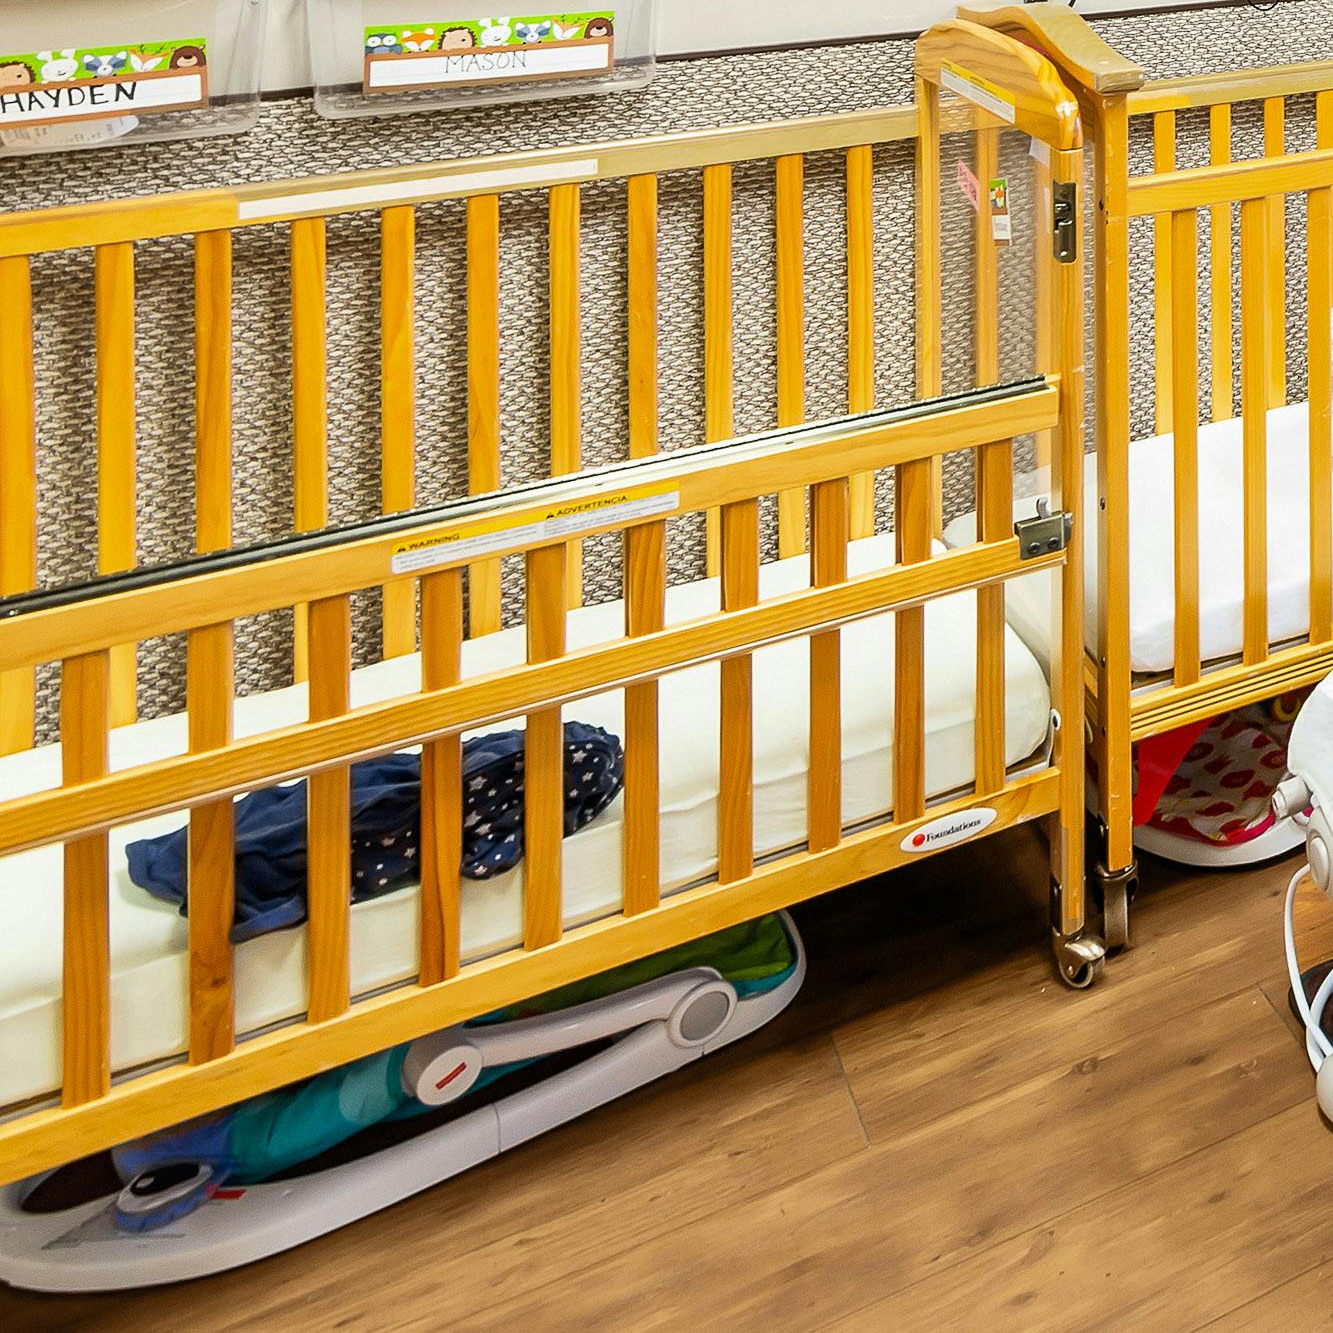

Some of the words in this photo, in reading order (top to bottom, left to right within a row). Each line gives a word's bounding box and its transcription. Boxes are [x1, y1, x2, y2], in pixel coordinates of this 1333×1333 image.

[444, 49, 528, 74] MASON
[0, 80, 137, 114] HAYDEN
[556, 495, 628, 516] ADVERTENCIA
[409, 533, 460, 551] WARNING
[926, 818, 982, 842] Foundations
